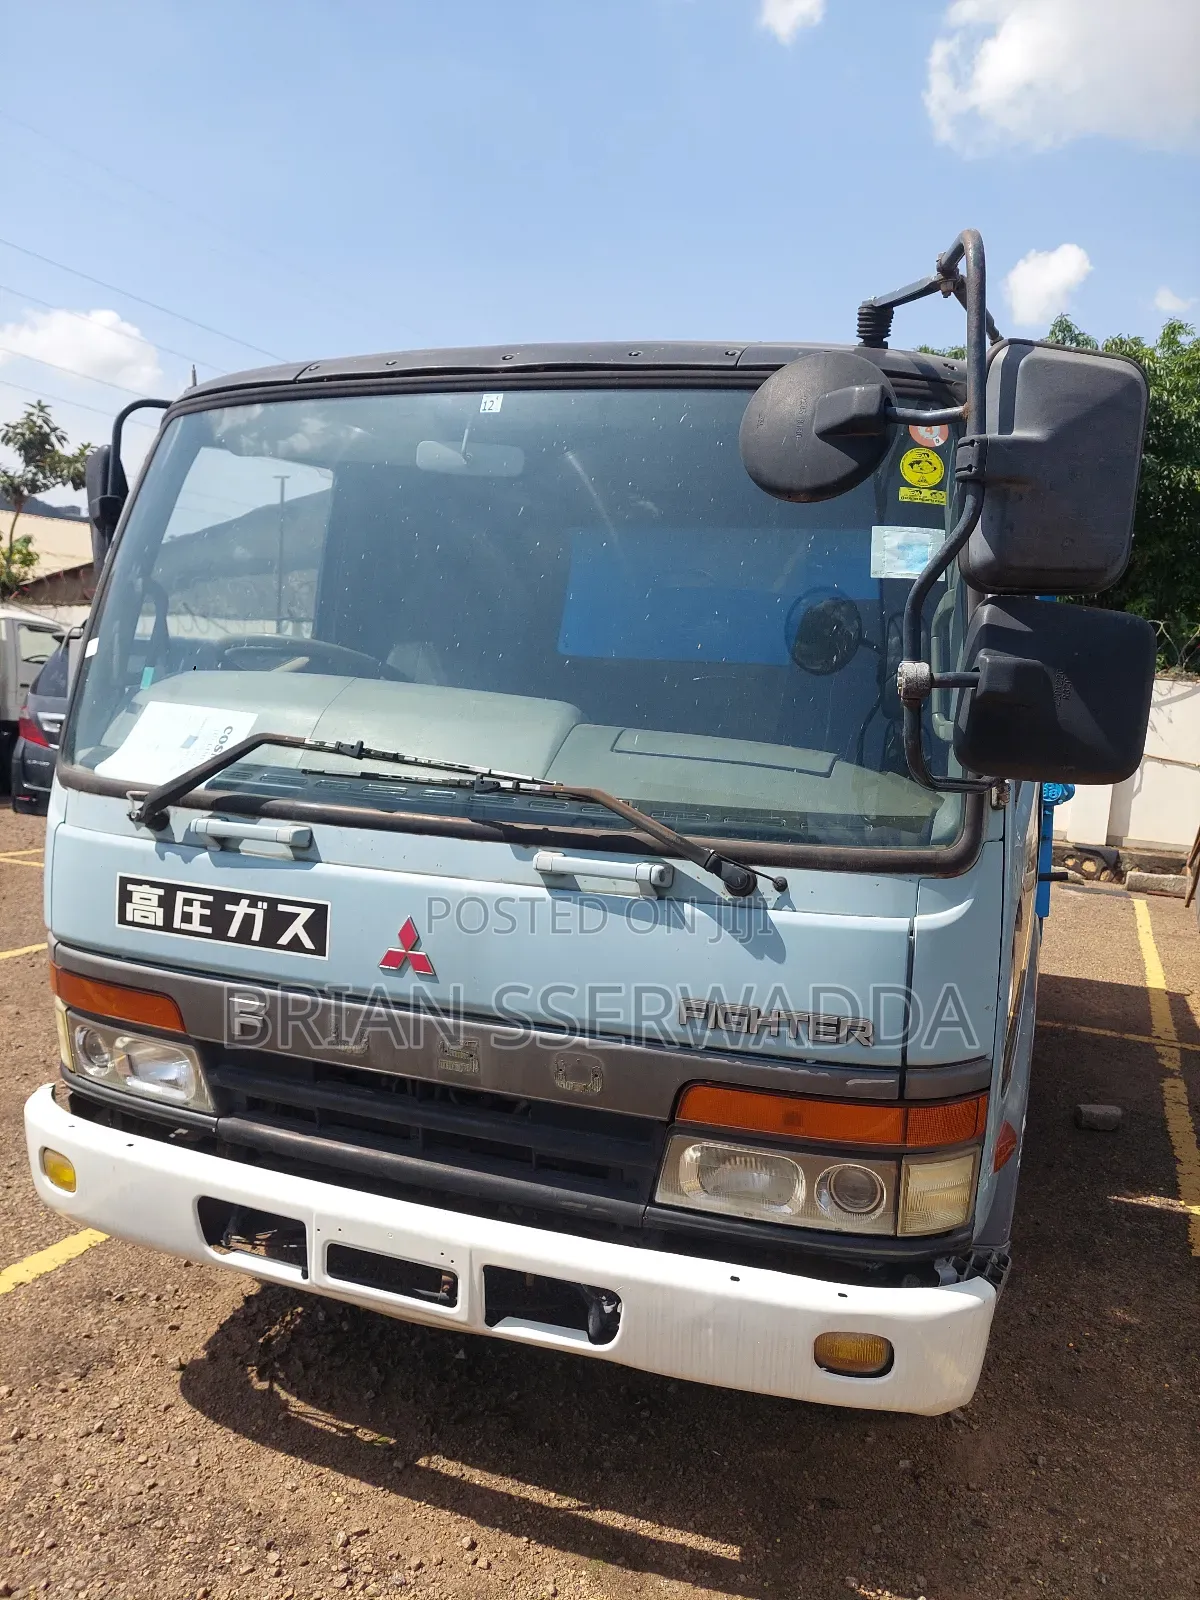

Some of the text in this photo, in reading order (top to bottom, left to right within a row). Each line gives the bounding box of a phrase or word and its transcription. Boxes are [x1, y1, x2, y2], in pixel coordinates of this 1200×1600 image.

[481, 399, 495, 411] 12
[209, 725, 234, 759] COS
[125, 883, 318, 951] 高圧ガス
[678, 997, 875, 1048] FIGHTER
